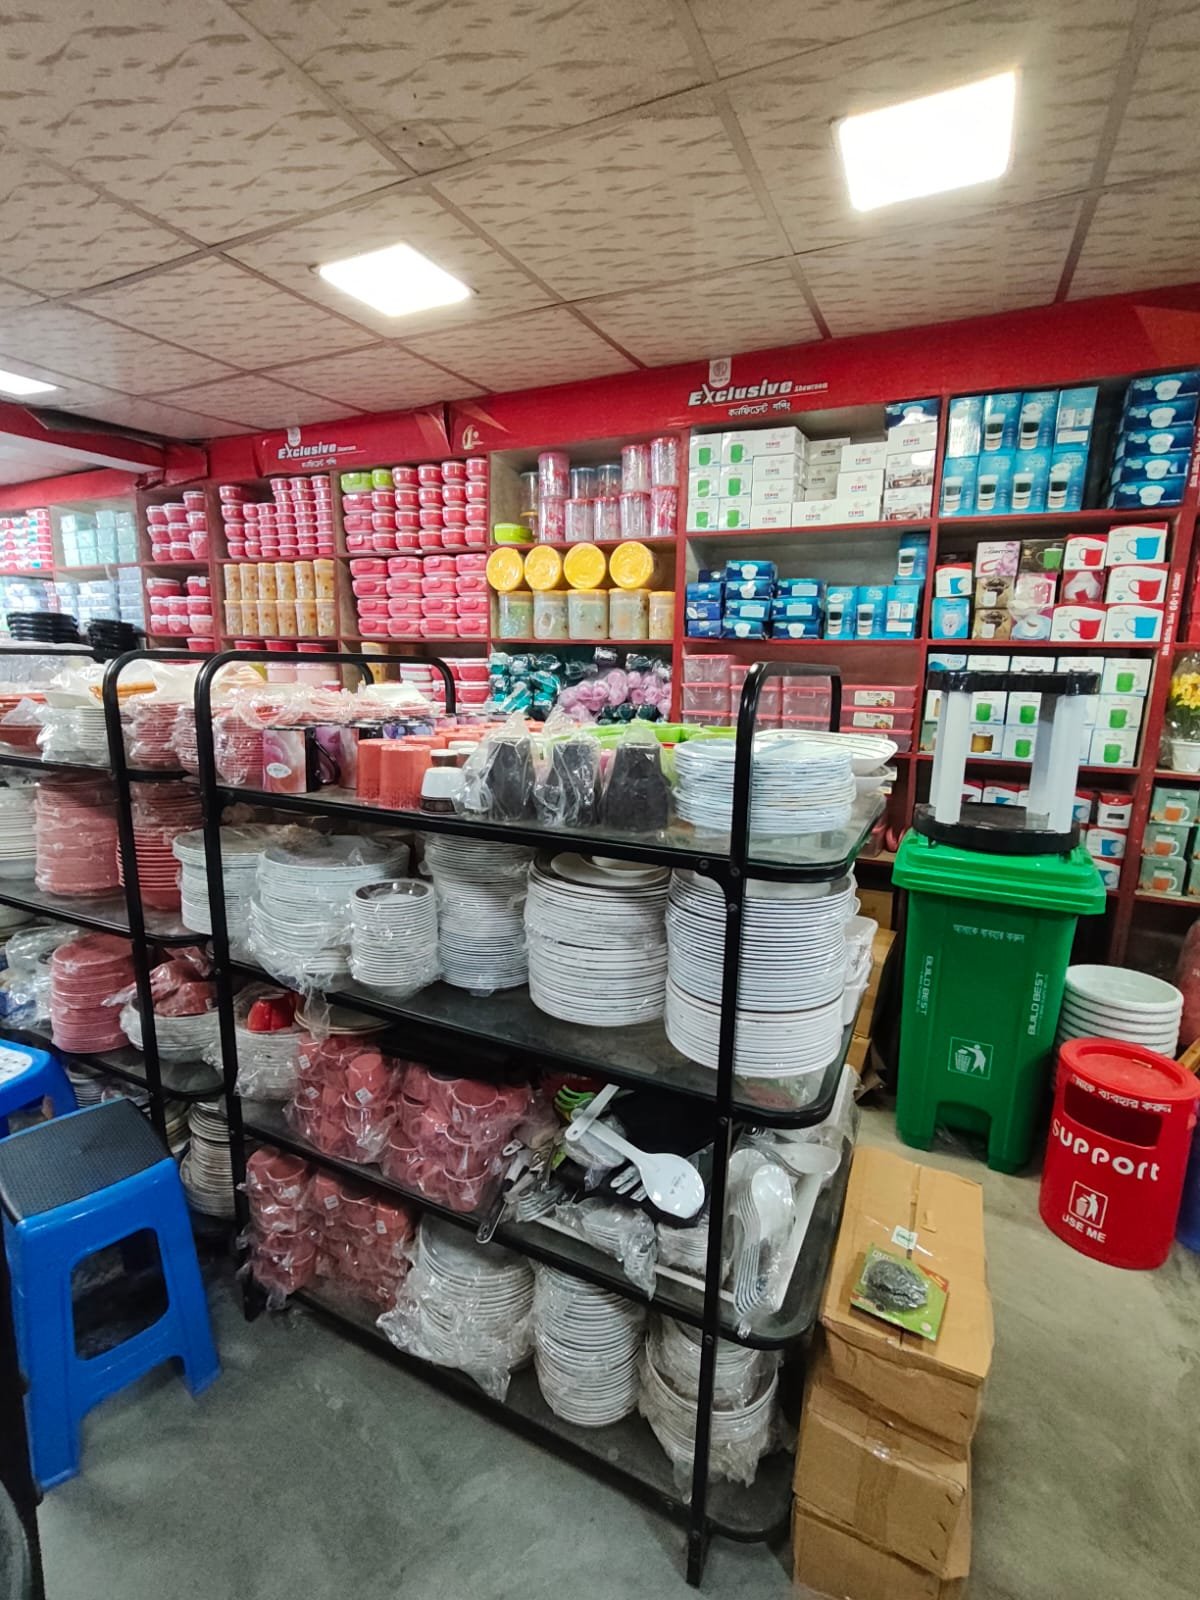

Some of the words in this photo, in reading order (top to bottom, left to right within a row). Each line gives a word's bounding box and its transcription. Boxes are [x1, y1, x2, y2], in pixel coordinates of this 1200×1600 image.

[688, 379, 793, 406] Exclusive
[278, 441, 337, 459] Exclusive
[1032, 971, 1044, 1002] BEST
[1027, 1003, 1040, 1036] BUILD
[1062, 1212, 1085, 1233] USE
[1086, 1227, 1107, 1244] ME
